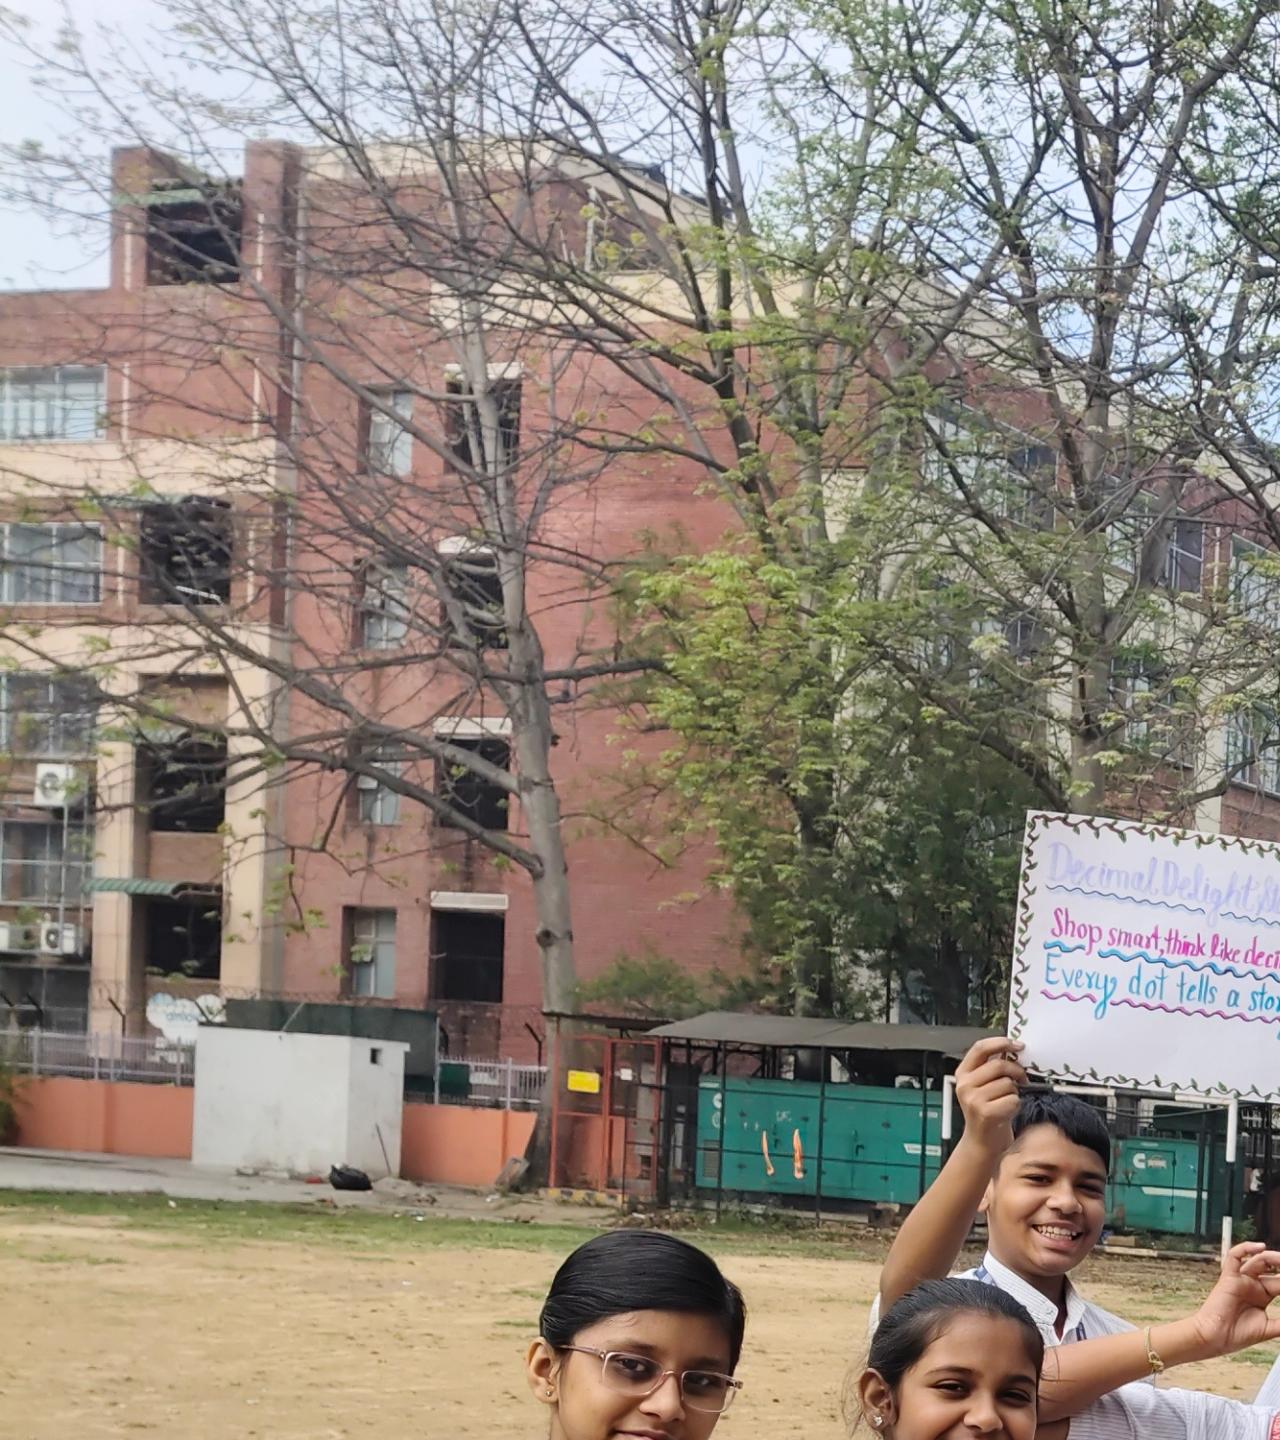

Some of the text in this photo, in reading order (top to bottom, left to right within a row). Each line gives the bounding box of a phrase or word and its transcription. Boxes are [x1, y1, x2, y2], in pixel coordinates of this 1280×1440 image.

[1051, 908, 1101, 956] Shop
[1164, 929, 1206, 958] think
[1211, 931, 1240, 964] like
[1044, 952, 1118, 1020] Every
[1128, 963, 1168, 999] dot
[1176, 973, 1217, 1006] tells
[1226, 989, 1240, 1009] a
